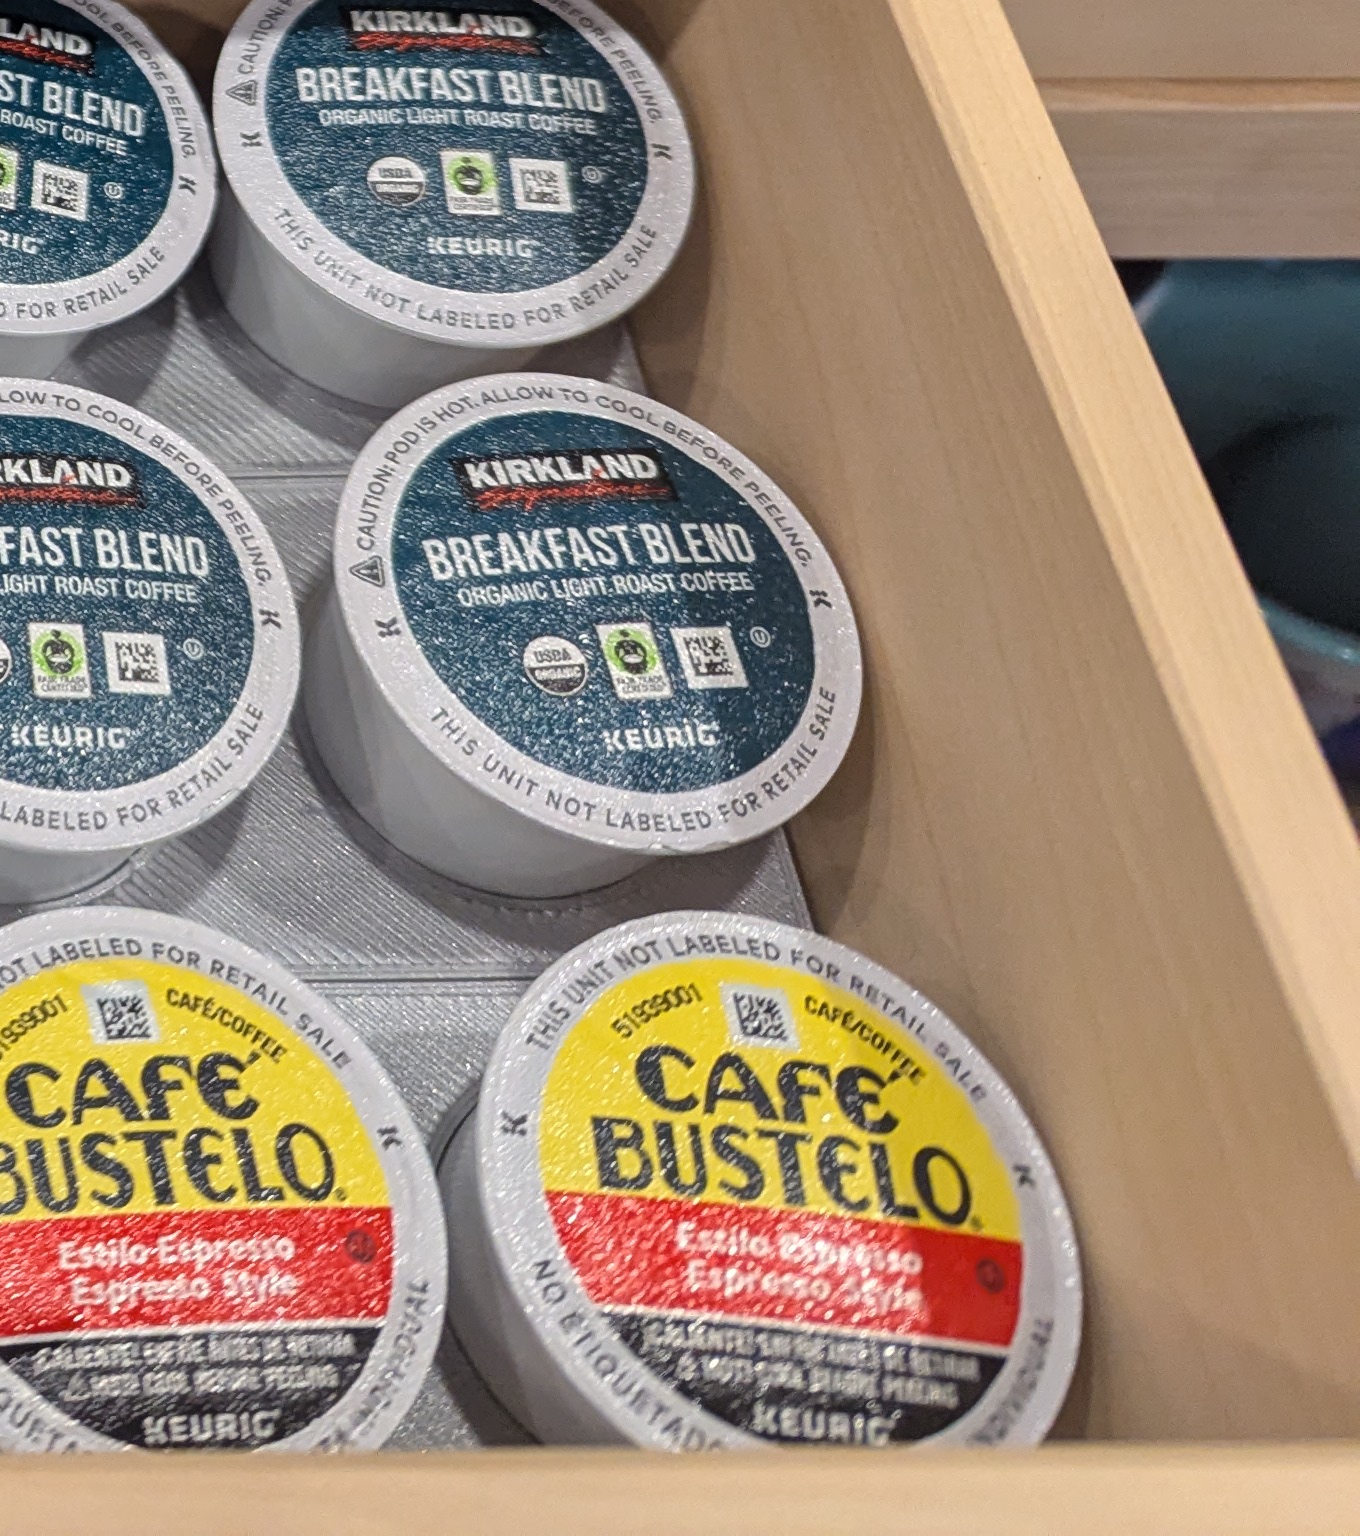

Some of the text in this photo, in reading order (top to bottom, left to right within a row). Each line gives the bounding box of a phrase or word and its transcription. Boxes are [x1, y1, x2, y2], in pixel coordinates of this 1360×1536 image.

[349, 11, 534, 37] KIRKLAND
[295, 67, 606, 112] BREAKFAST BLEND
[42, 81, 145, 137] BLEND
[318, 108, 598, 134] ORGANIC LIGHT ROAST COFFEE
[0, 110, 59, 136] ROAST
[62, 122, 128, 156] COFFEE
[427, 236, 533, 258] KEURIG
[463, 454, 659, 491] KIRKLAND
[95, 529, 208, 576] BLEND
[421, 522, 755, 582] BREAKFAST BLEND
[55, 577, 121, 597] ROAST
[127, 579, 198, 602] COFFEE
[457, 572, 754, 608] ORGANIC LIGHT ROAST COFFEE
[12, 725, 129, 749] KEURIG
[603, 723, 719, 753] KEURIG
[0, 801, 109, 830] LABELED
[117, 801, 160, 825] FOR
[167, 761, 233, 808] RETAIL
[228, 706, 264, 756] SALE
[591, 1115, 973, 1227] BUSTELO
[58, 1234, 295, 1268] Estilo Espresso
[71, 1270, 299, 1308] Espresso Style
[141, 1411, 279, 1444] KEURIG
[751, 1407, 891, 1447] KEURIG
